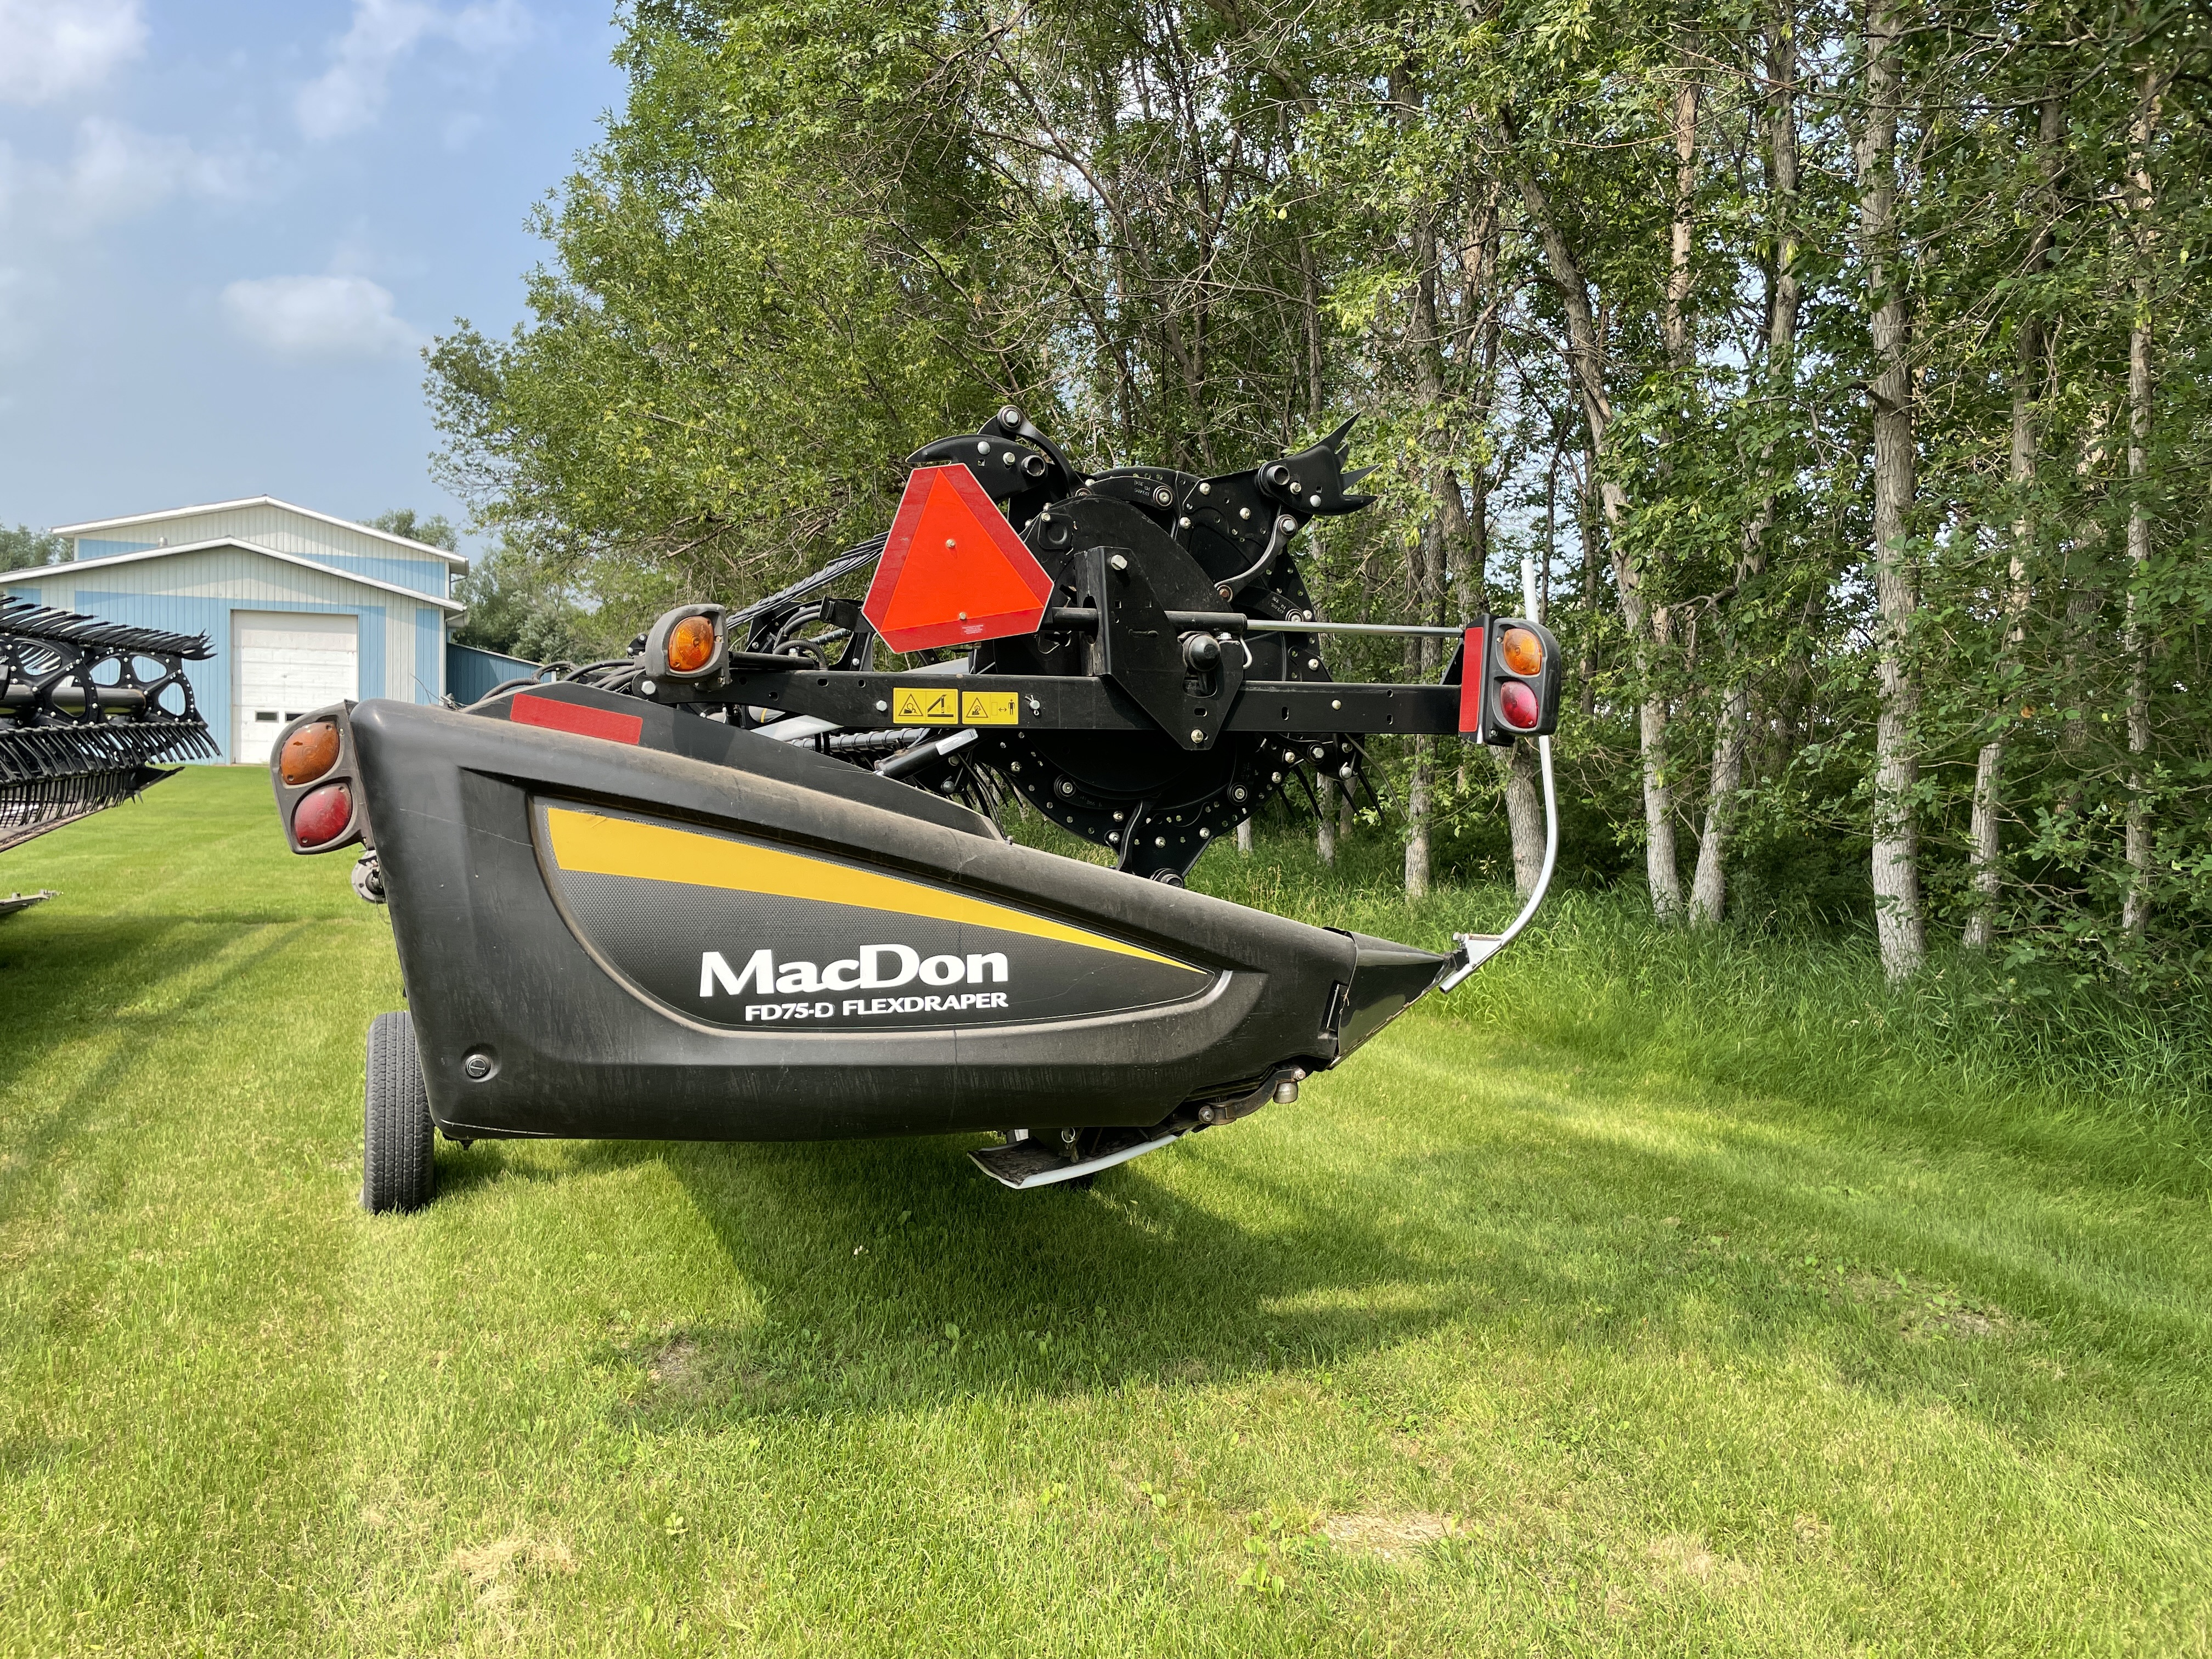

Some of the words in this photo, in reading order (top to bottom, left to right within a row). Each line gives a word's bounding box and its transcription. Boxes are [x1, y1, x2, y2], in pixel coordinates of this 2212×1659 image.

[699, 944, 1009, 997] MacDon
[745, 1002, 834, 1021] FD75-D
[843, 992, 1009, 1016] FLEXDRAPER
